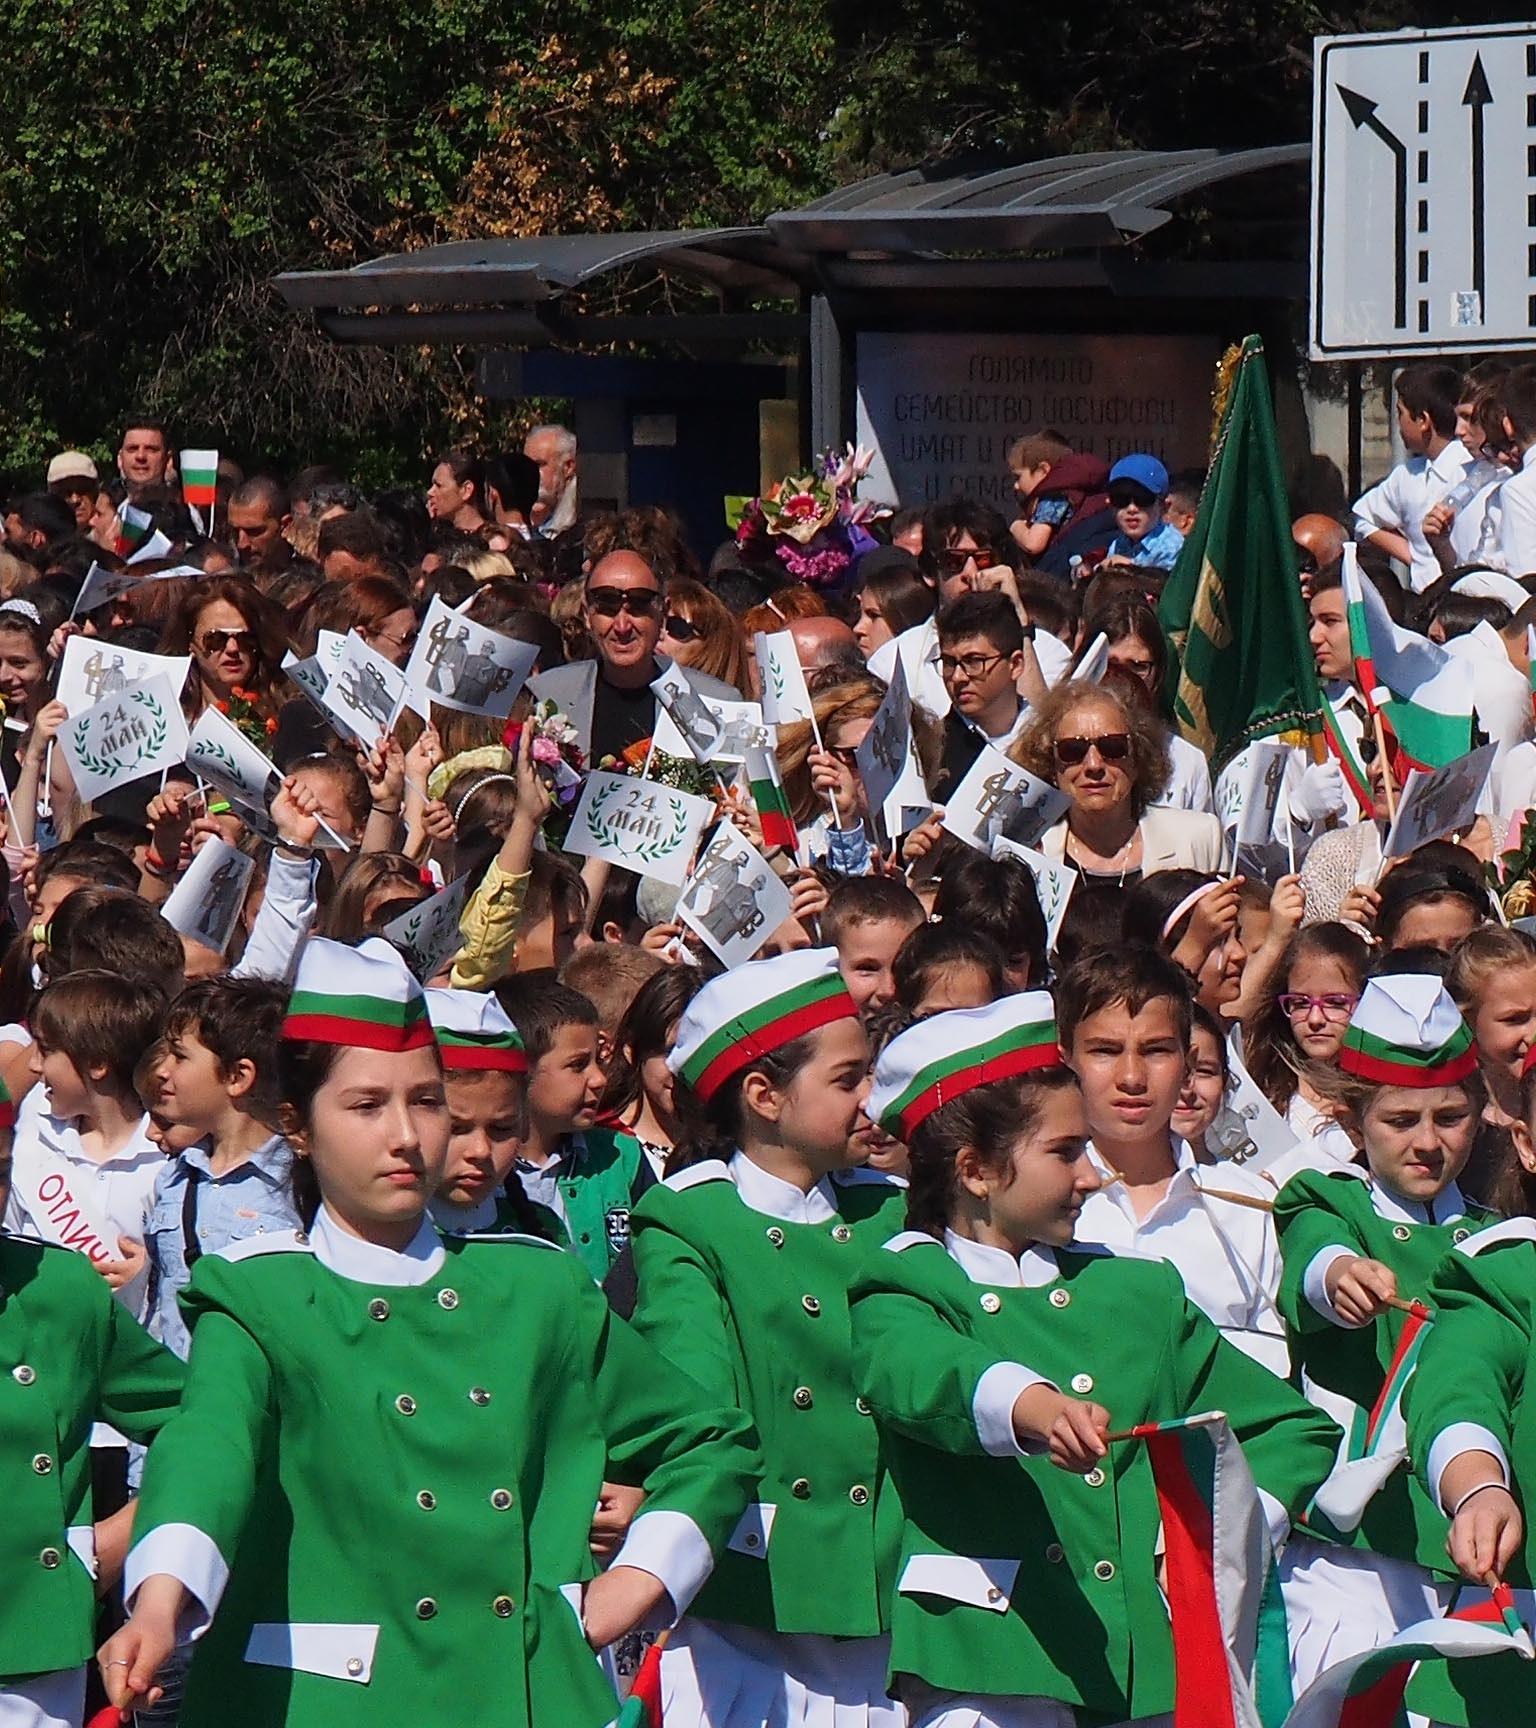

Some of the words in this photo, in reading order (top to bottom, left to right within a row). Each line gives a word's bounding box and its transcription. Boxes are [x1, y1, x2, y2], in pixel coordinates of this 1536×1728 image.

[968, 352, 1095, 385] ГОЛЯМОТО
[893, 390, 1033, 425] СЕМЕЙСТВО
[1042, 392, 1177, 426] ЙОСИФОВИ
[899, 433, 968, 464] ИМАТ
[99, 703, 129, 731] 24
[100, 715, 149, 758] МАЙ
[625, 789, 657, 811] 24
[606, 808, 664, 840] МАЙ
[38, 1174, 114, 1263] ОТЛИЧ
